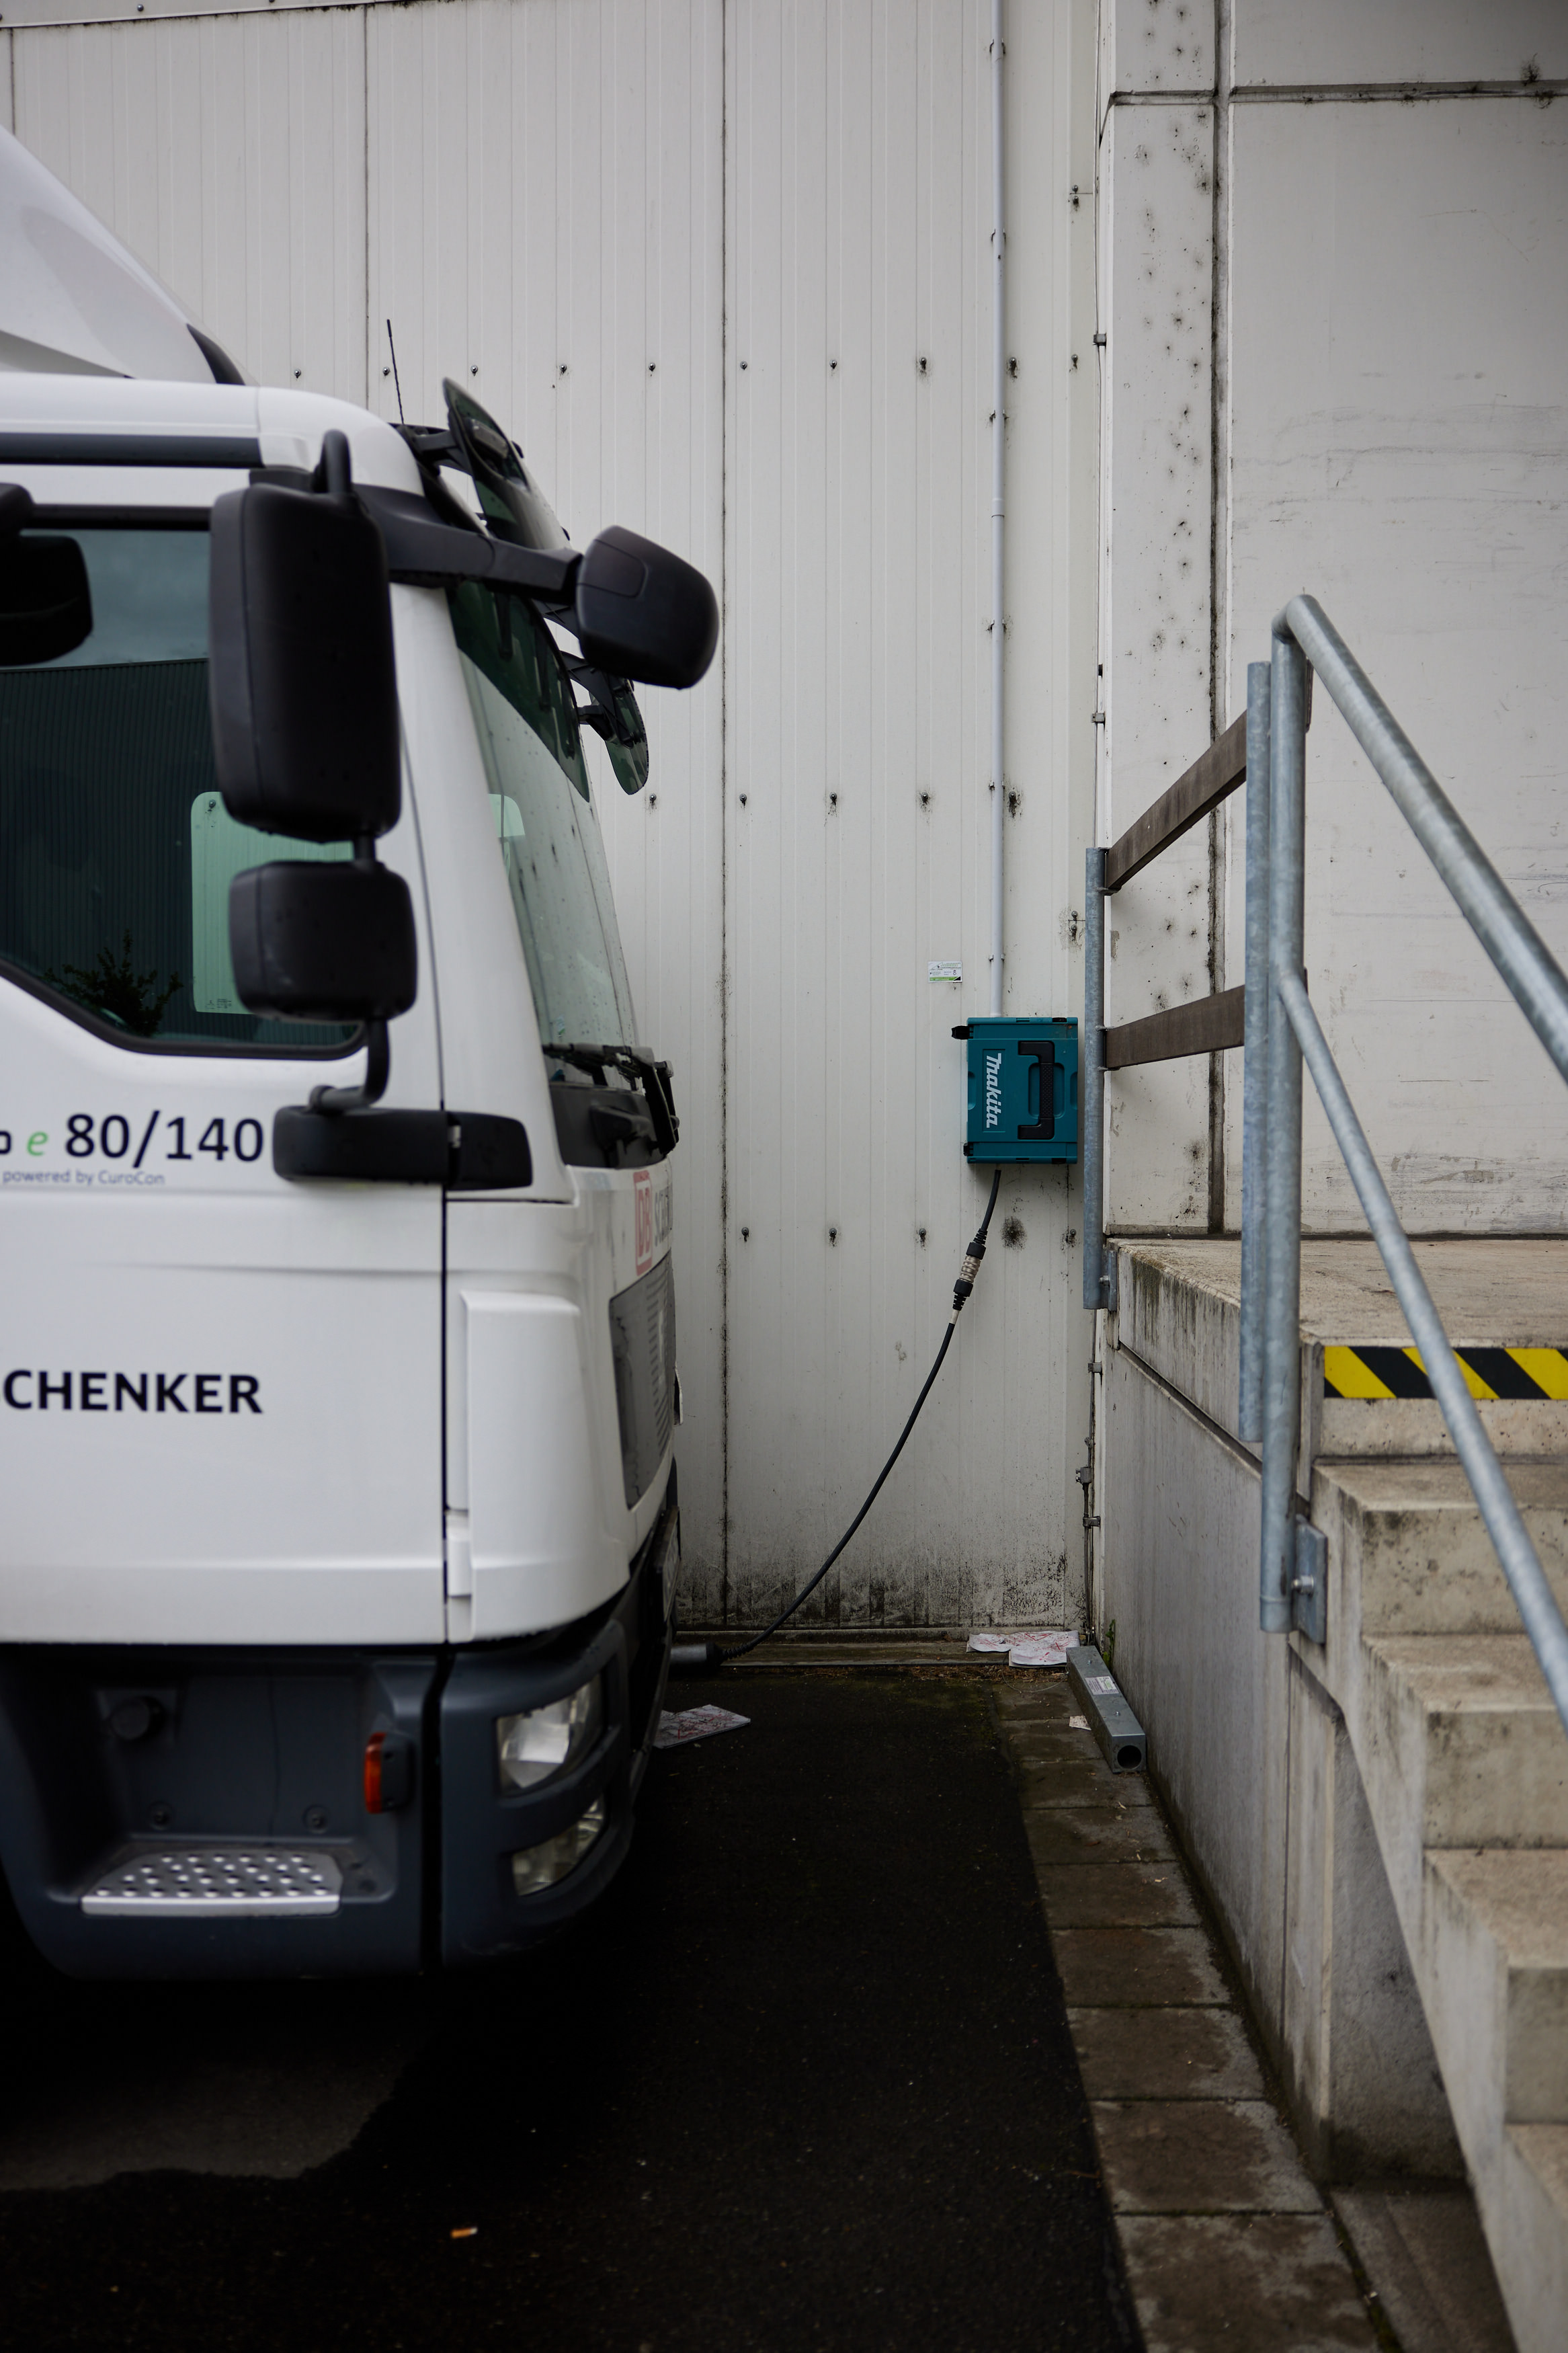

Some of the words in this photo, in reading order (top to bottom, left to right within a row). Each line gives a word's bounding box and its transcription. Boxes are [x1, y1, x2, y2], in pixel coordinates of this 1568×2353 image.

[986, 1053, 1001, 1128] Makita
[27, 1131, 48, 1156] e
[65, 1110, 264, 1168] 80/140
[3, 1170, 71, 1184] powered
[76, 1169, 92, 1185] by
[98, 1170, 165, 1185] CuroCon
[3, 1369, 263, 1414] CHENKER
